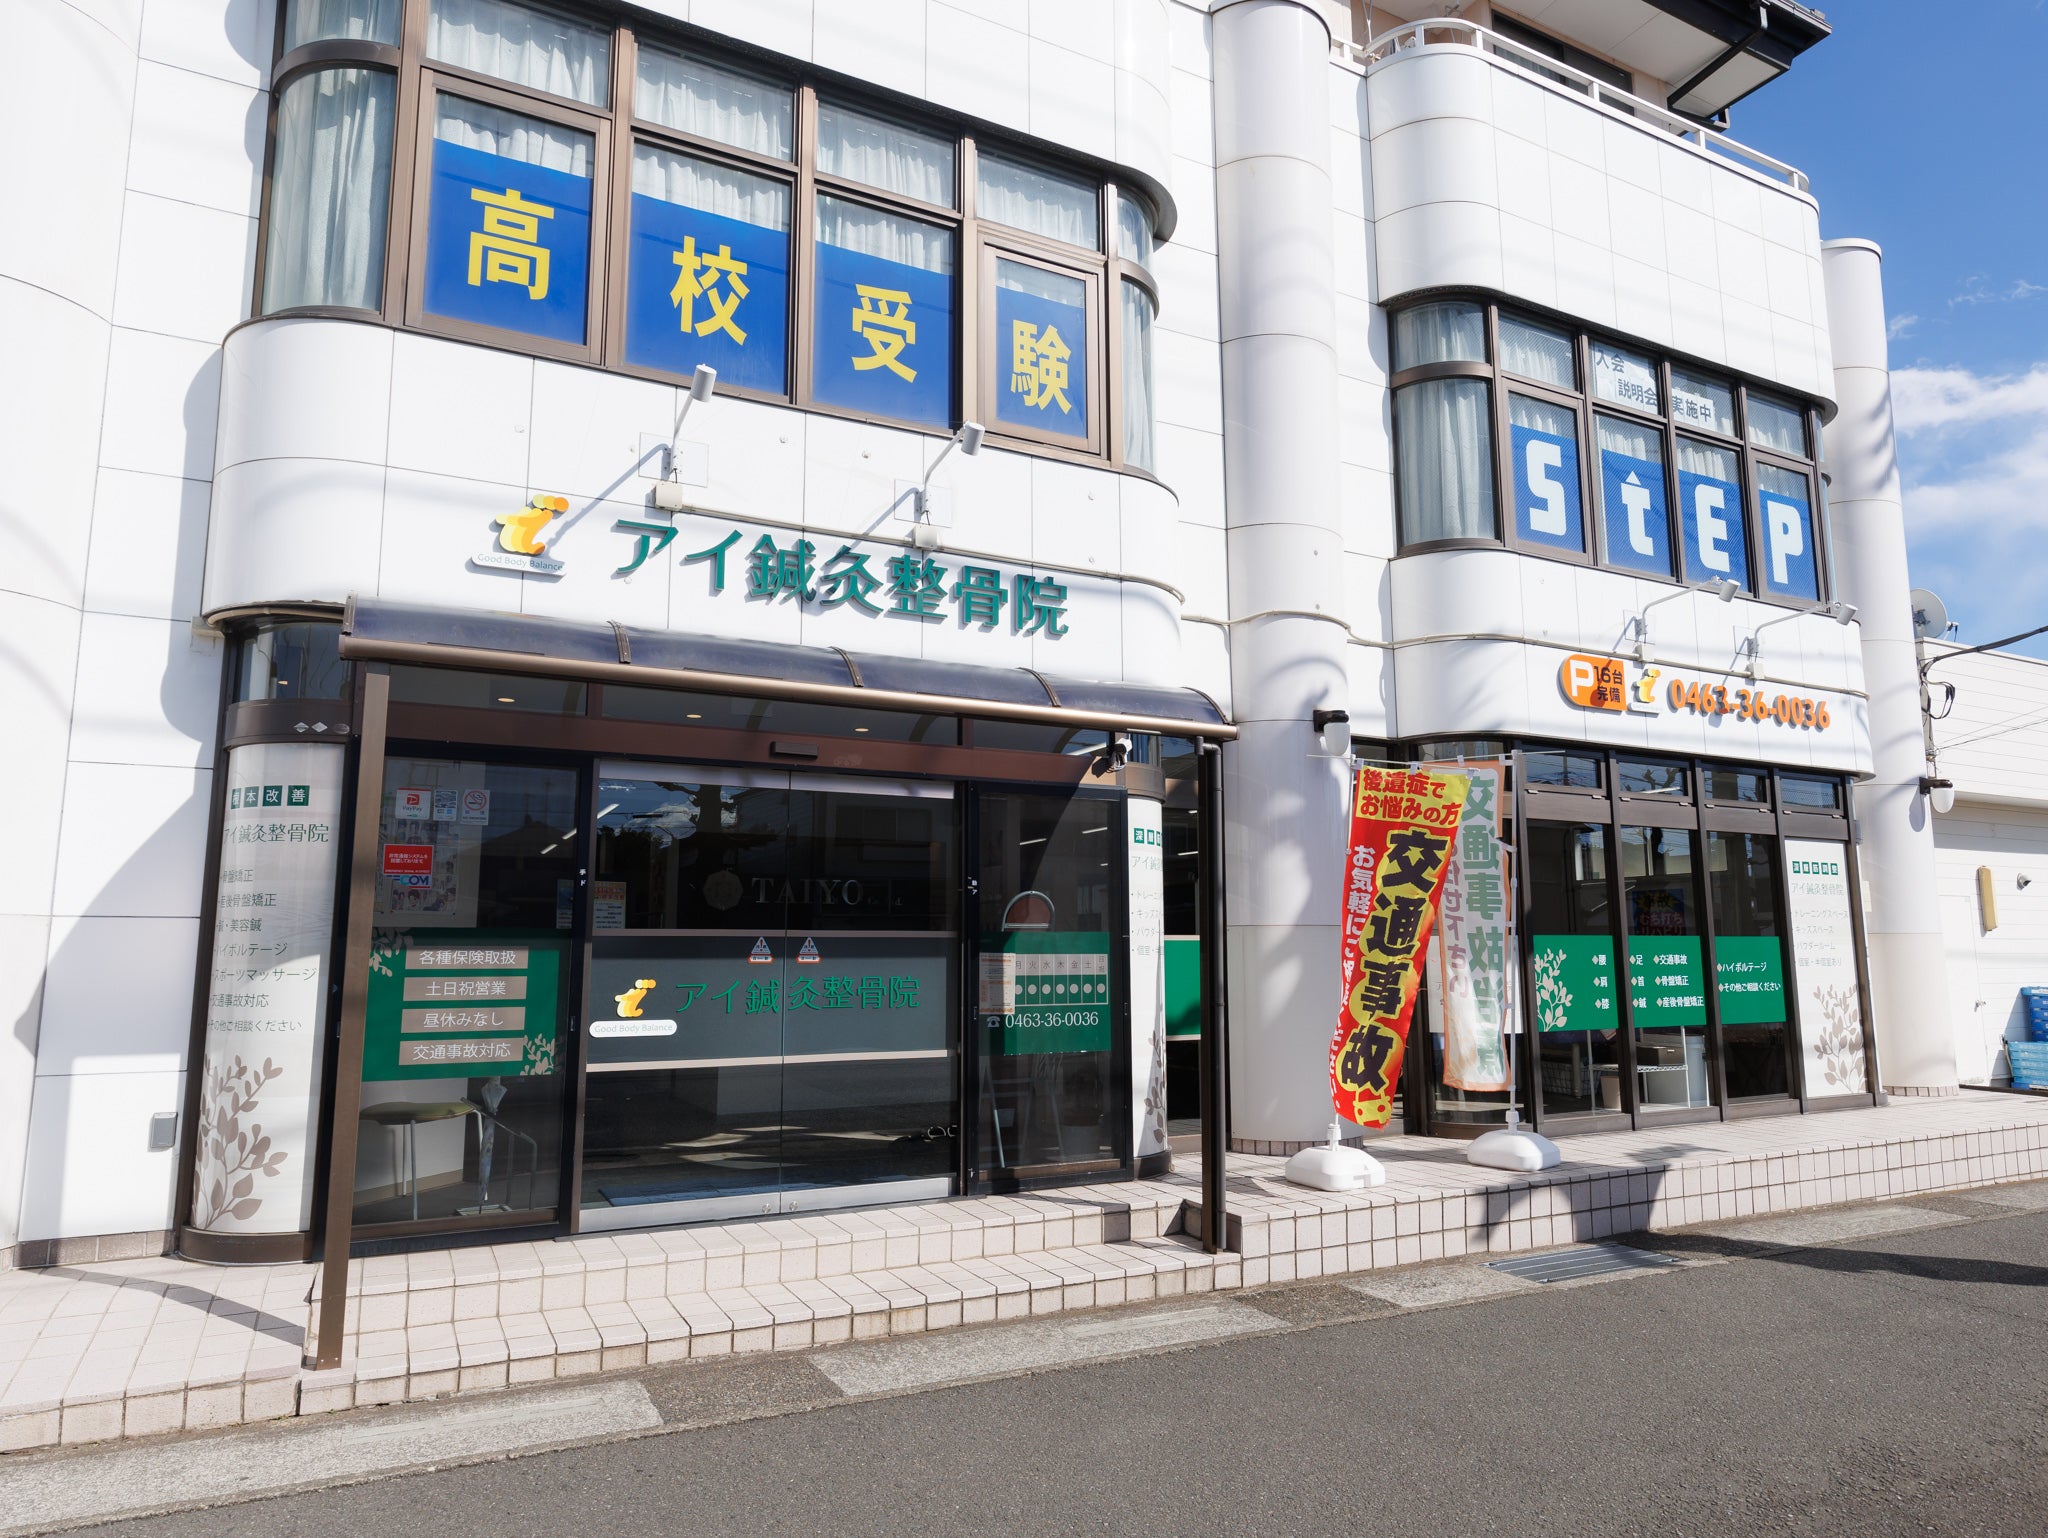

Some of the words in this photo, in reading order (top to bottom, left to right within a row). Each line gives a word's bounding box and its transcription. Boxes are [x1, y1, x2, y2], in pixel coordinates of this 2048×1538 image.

[467, 187, 1072, 415] 高校受験
[1595, 349, 1625, 374] 入会
[477, 553, 503, 564] Good
[504, 556, 528, 569] Body
[529, 560, 564, 571] Balance
[615, 517, 1072, 637] アイ鍼灸整骨院
[1569, 659, 1595, 697] P
[1596, 685, 1621, 703] 完備
[1670, 678, 1831, 729] 0463-36-0036
[1363, 768, 1446, 800] 後遺症で
[1360, 793, 1463, 827] お悩みの方
[418, 950, 517, 966] 各種保険取扱
[1029, 960, 1037, 969] 火
[1042, 960, 1051, 969] 水
[1057, 960, 1065, 969] 木
[1071, 960, 1080, 969] 金
[1084, 960, 1093, 969] 土
[1340, 829, 1451, 1091] 交通事故
[1636, 954, 1644, 966] 足
[1658, 954, 1688, 966] 交通事故
[1722, 961, 1768, 973] ハイボルテージ
[425, 981, 507, 996] 土日祝営業
[1599, 976, 1608, 988] 肩
[1637, 975, 1645, 987] 首
[1660, 975, 1690, 987] 骨盤矯正
[1723, 982, 1782, 993] その他ご相談ください
[676, 975, 921, 1015] アイ鍼灸整骨院
[1662, 995, 1705, 1008] 産後骨盤矯正
[423, 1011, 504, 1028] 昼休みなし
[1004, 1011, 1100, 1029] 0463-36-0036
[594, 1024, 617, 1034] Good
[619, 1024, 640, 1035] Body
[641, 1023, 673, 1033] Balance
[412, 1042, 512, 1061] 交通事故対応
